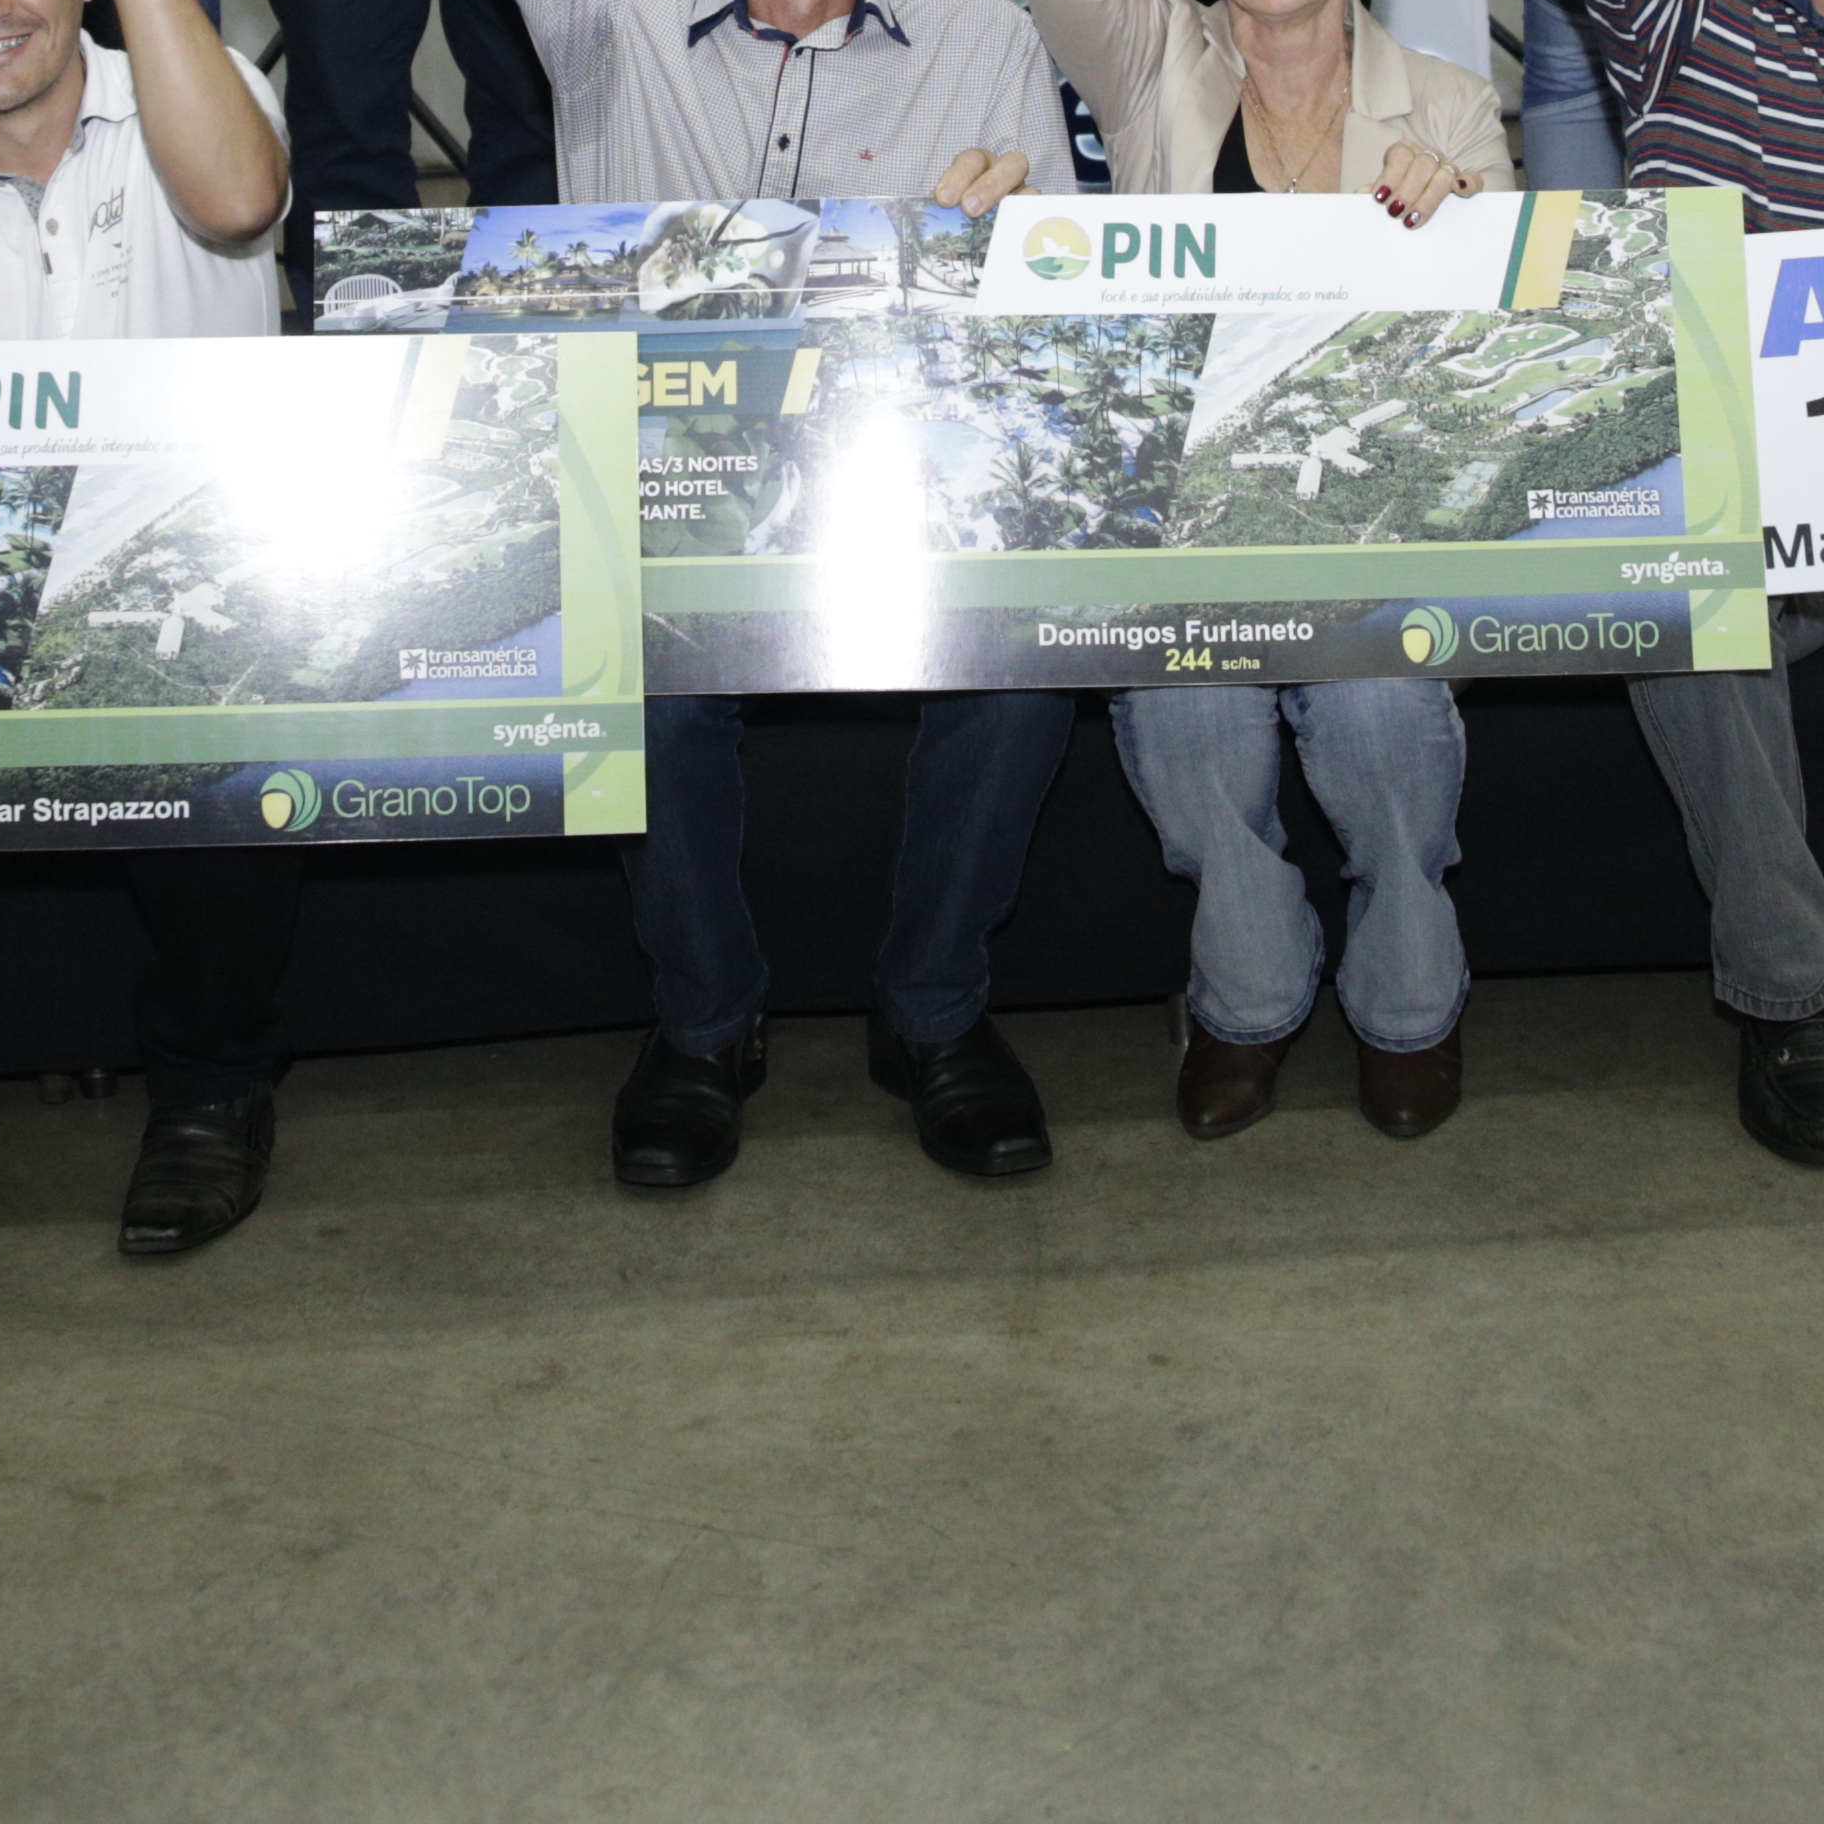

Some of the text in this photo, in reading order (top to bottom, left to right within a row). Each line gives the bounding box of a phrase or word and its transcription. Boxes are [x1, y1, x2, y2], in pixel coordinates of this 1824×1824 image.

[1101, 222, 1216, 279] PIN
[1101, 288, 1126, 302] Você
[1141, 292, 1158, 302] sua
[1296, 291, 1310, 301] ao
[0, 445, 18, 455] sua
[639, 456, 758, 475] AS/3 NOITES
[665, 479, 728, 496] HOTEL
[1555, 487, 1660, 504] transamérica
[1556, 502, 1660, 518] comandatuba
[1621, 557, 1724, 584] syngenta
[1038, 619, 1314, 650] Domingos Furlaneto
[428, 646, 537, 664] transamérica
[1165, 647, 1260, 671] 244 sc/ha
[429, 661, 537, 678] comandatuba
[493, 719, 600, 747] syngenta
[33, 795, 190, 827] Strapazzon
